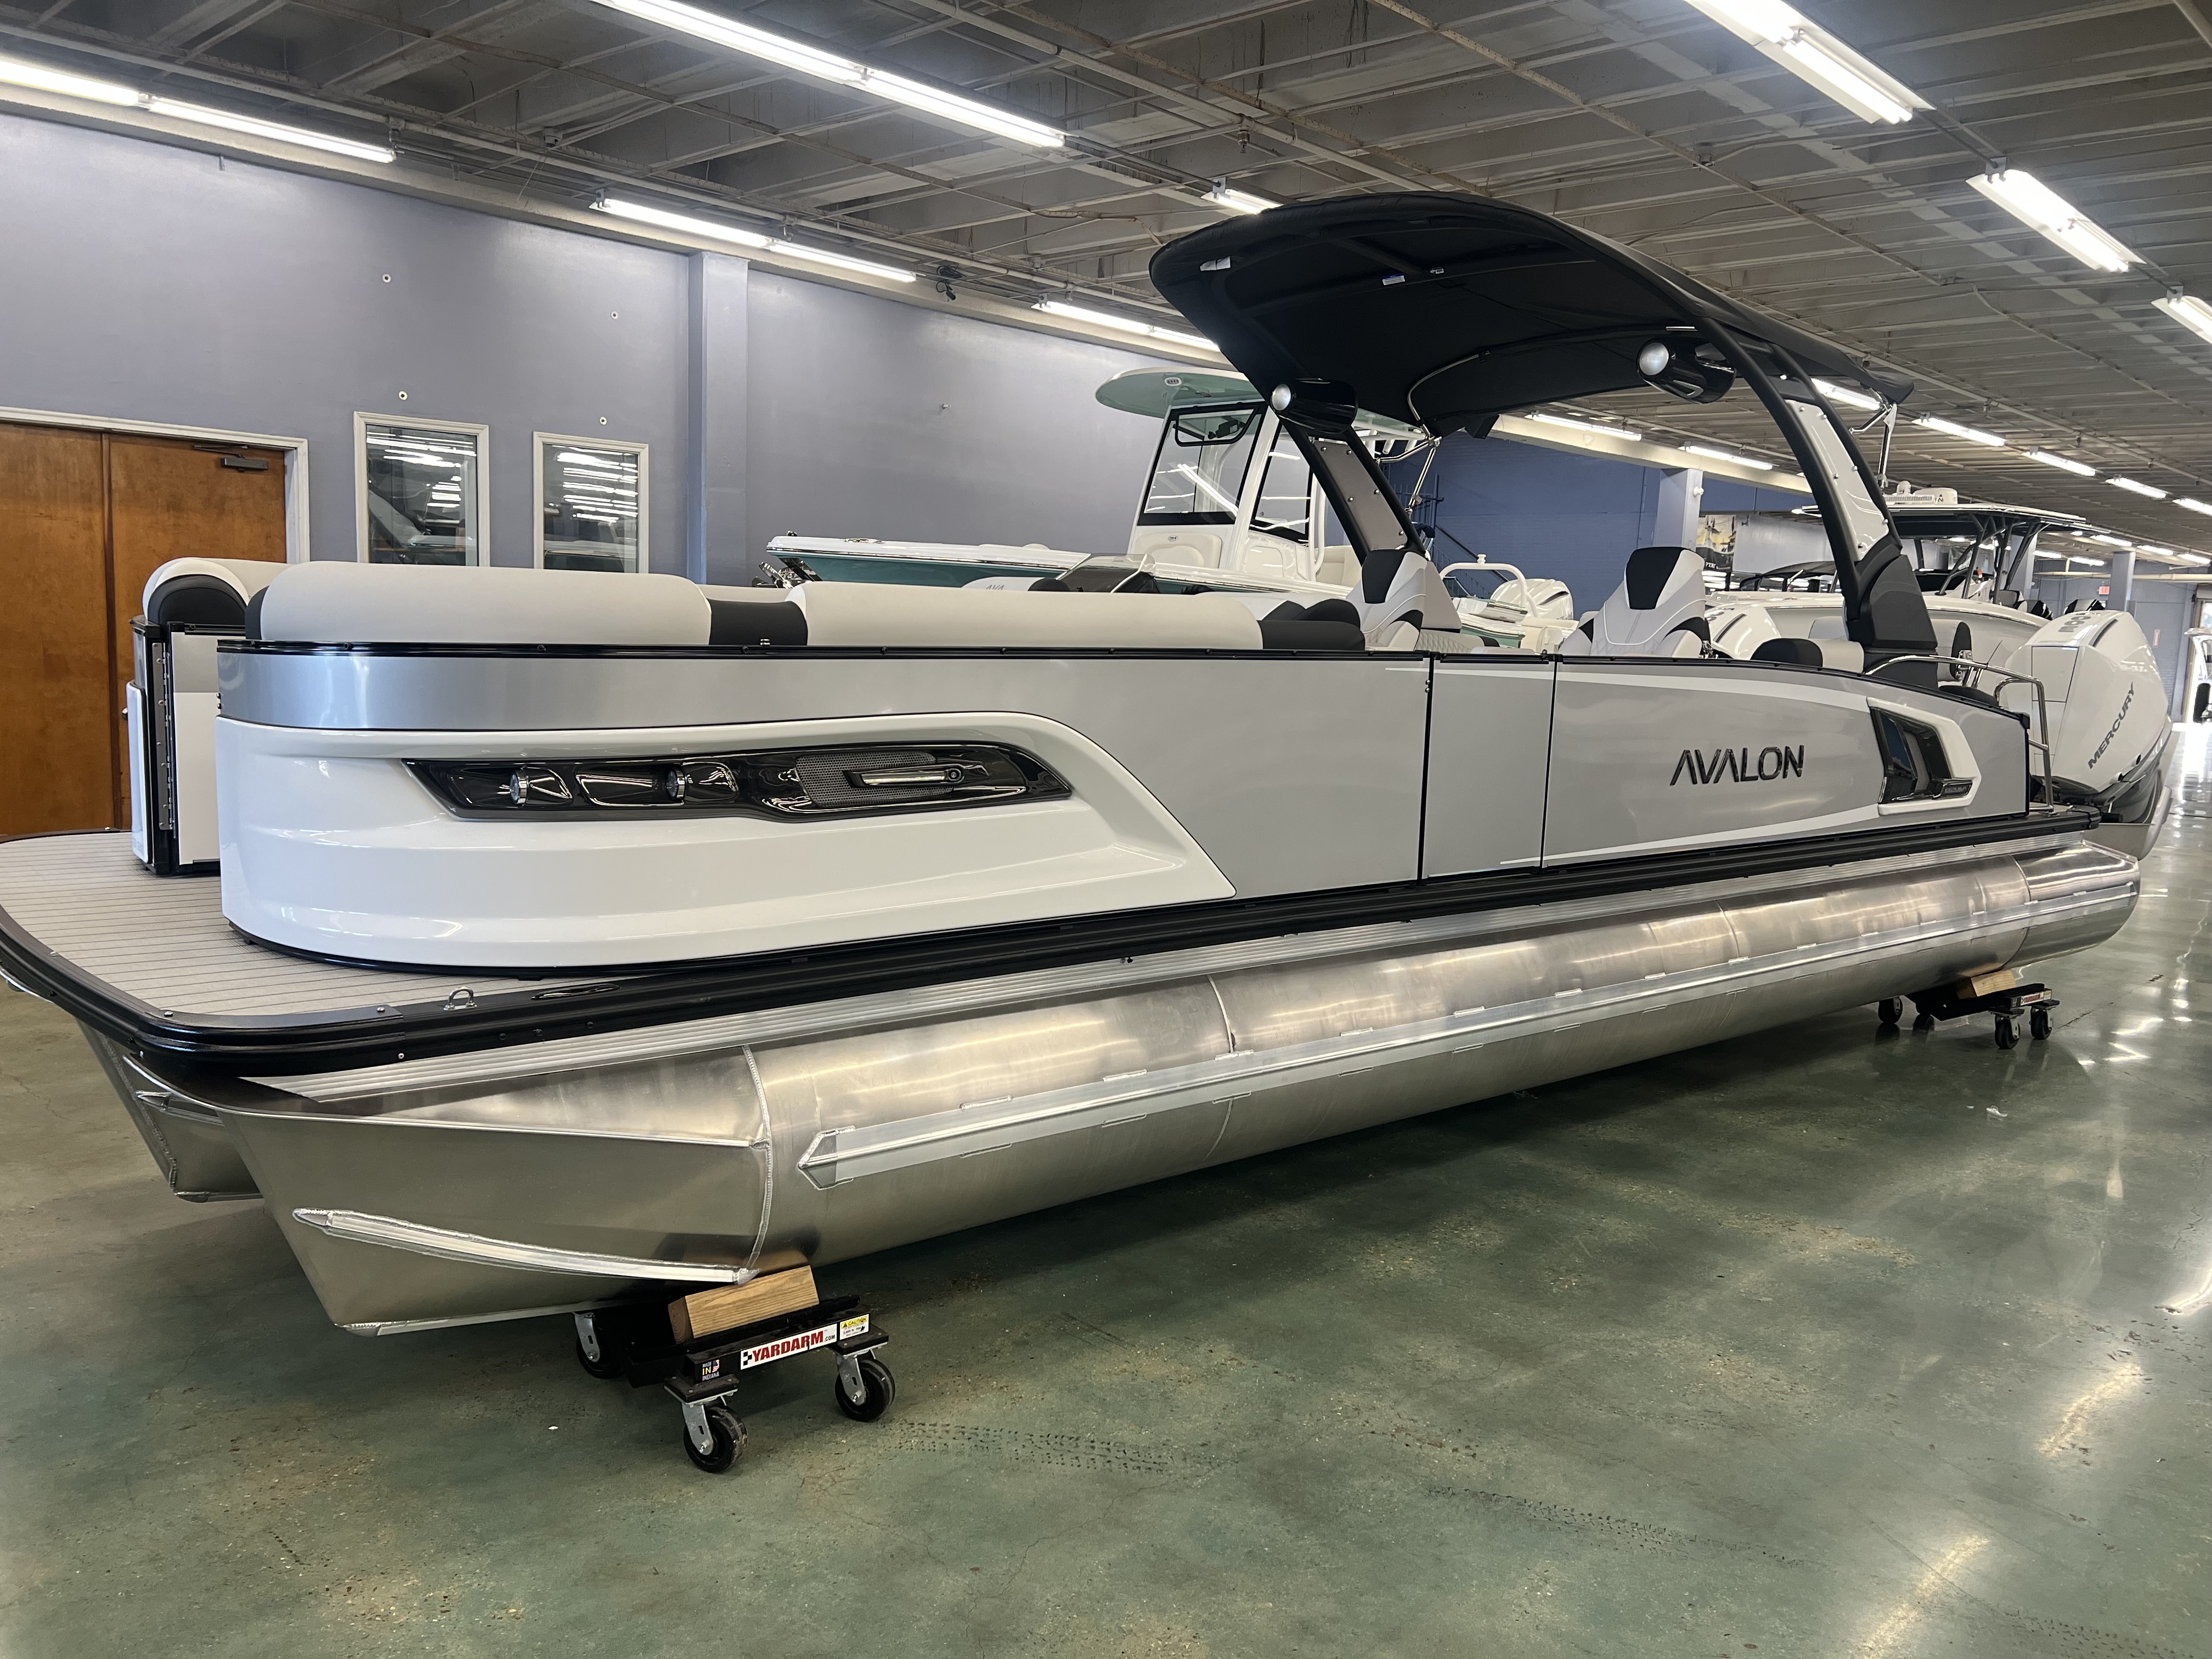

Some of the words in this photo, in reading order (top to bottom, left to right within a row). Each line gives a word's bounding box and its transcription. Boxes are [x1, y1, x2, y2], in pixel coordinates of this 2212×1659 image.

[2087, 681, 2134, 769] MERCURY
[1669, 744, 1804, 786] AVALON
[752, 1330, 823, 1362] YARDARM
[702, 1366, 712, 1375] IN
[702, 1371, 720, 1381] INDIANA
